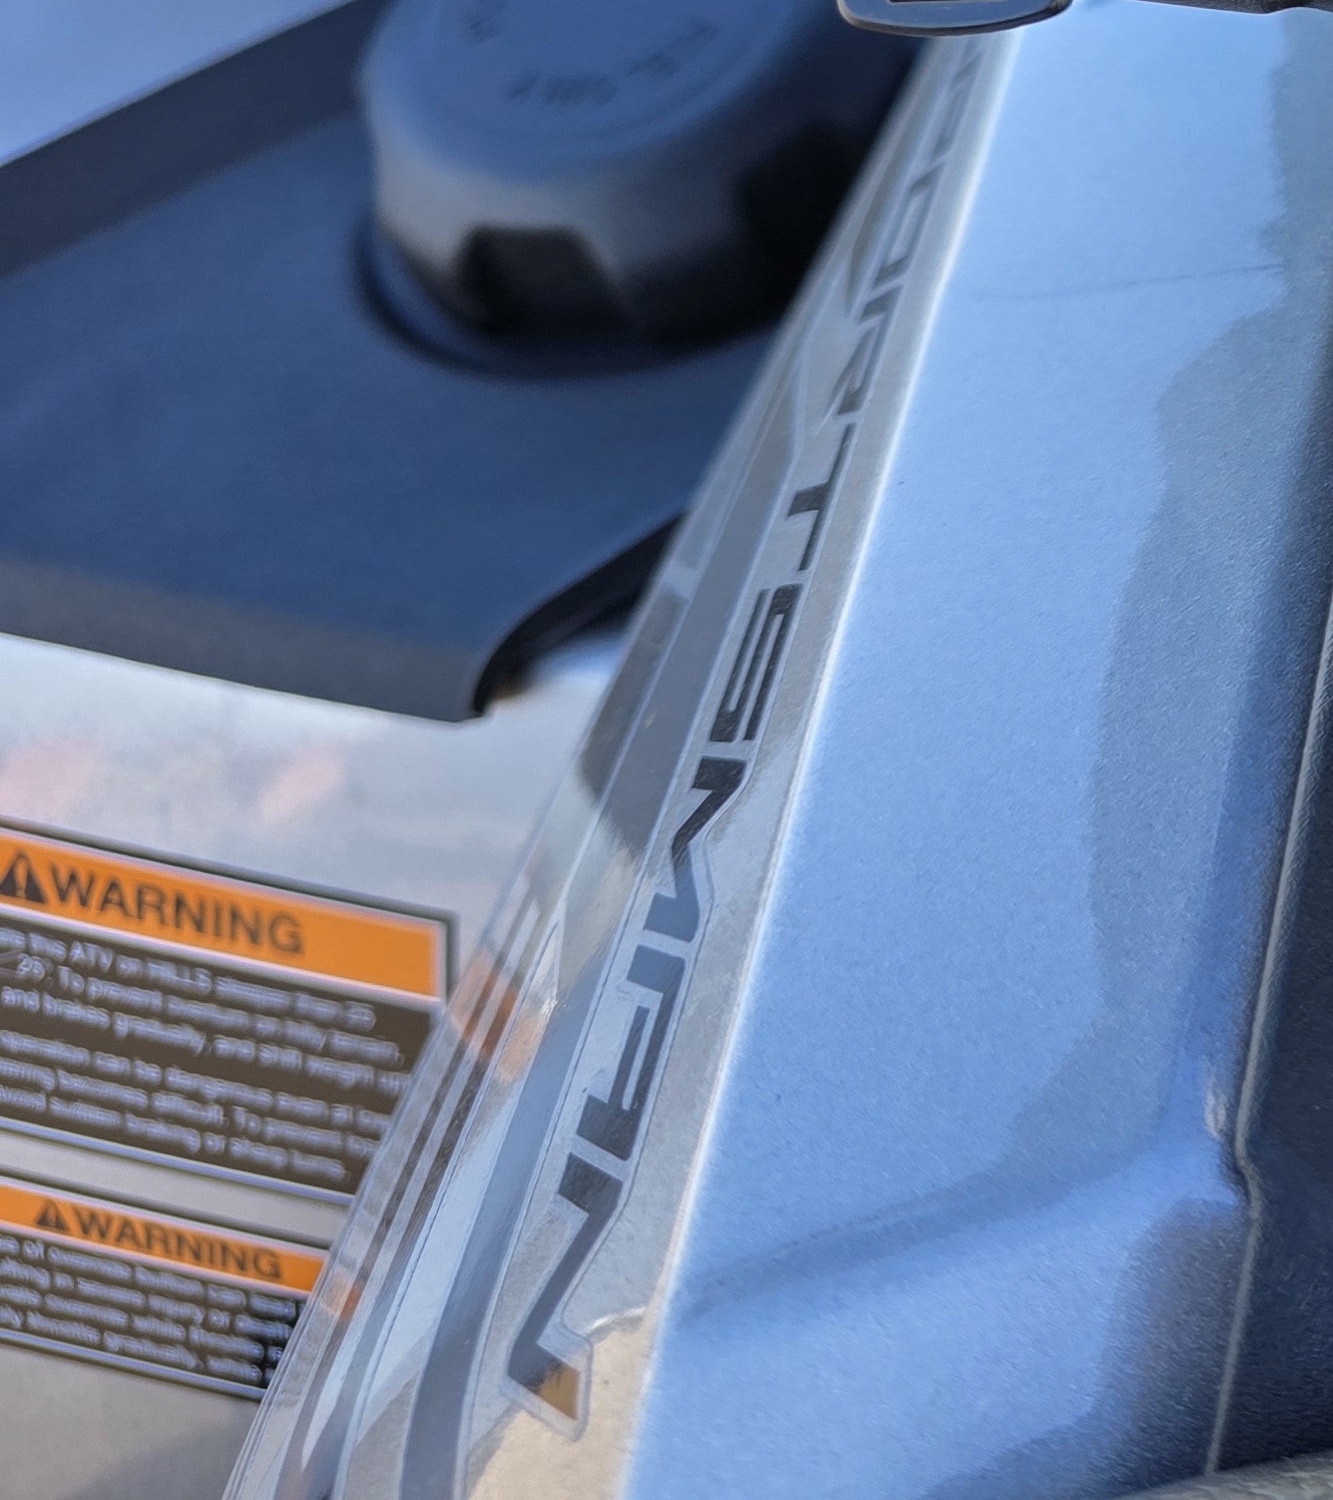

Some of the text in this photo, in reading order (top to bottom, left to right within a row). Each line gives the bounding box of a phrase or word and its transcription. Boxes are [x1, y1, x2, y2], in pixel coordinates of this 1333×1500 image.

[507, 32, 992, 1421] PORTSMAN
[49, 861, 305, 955] WARNING
[73, 1202, 282, 1280] WARNING
